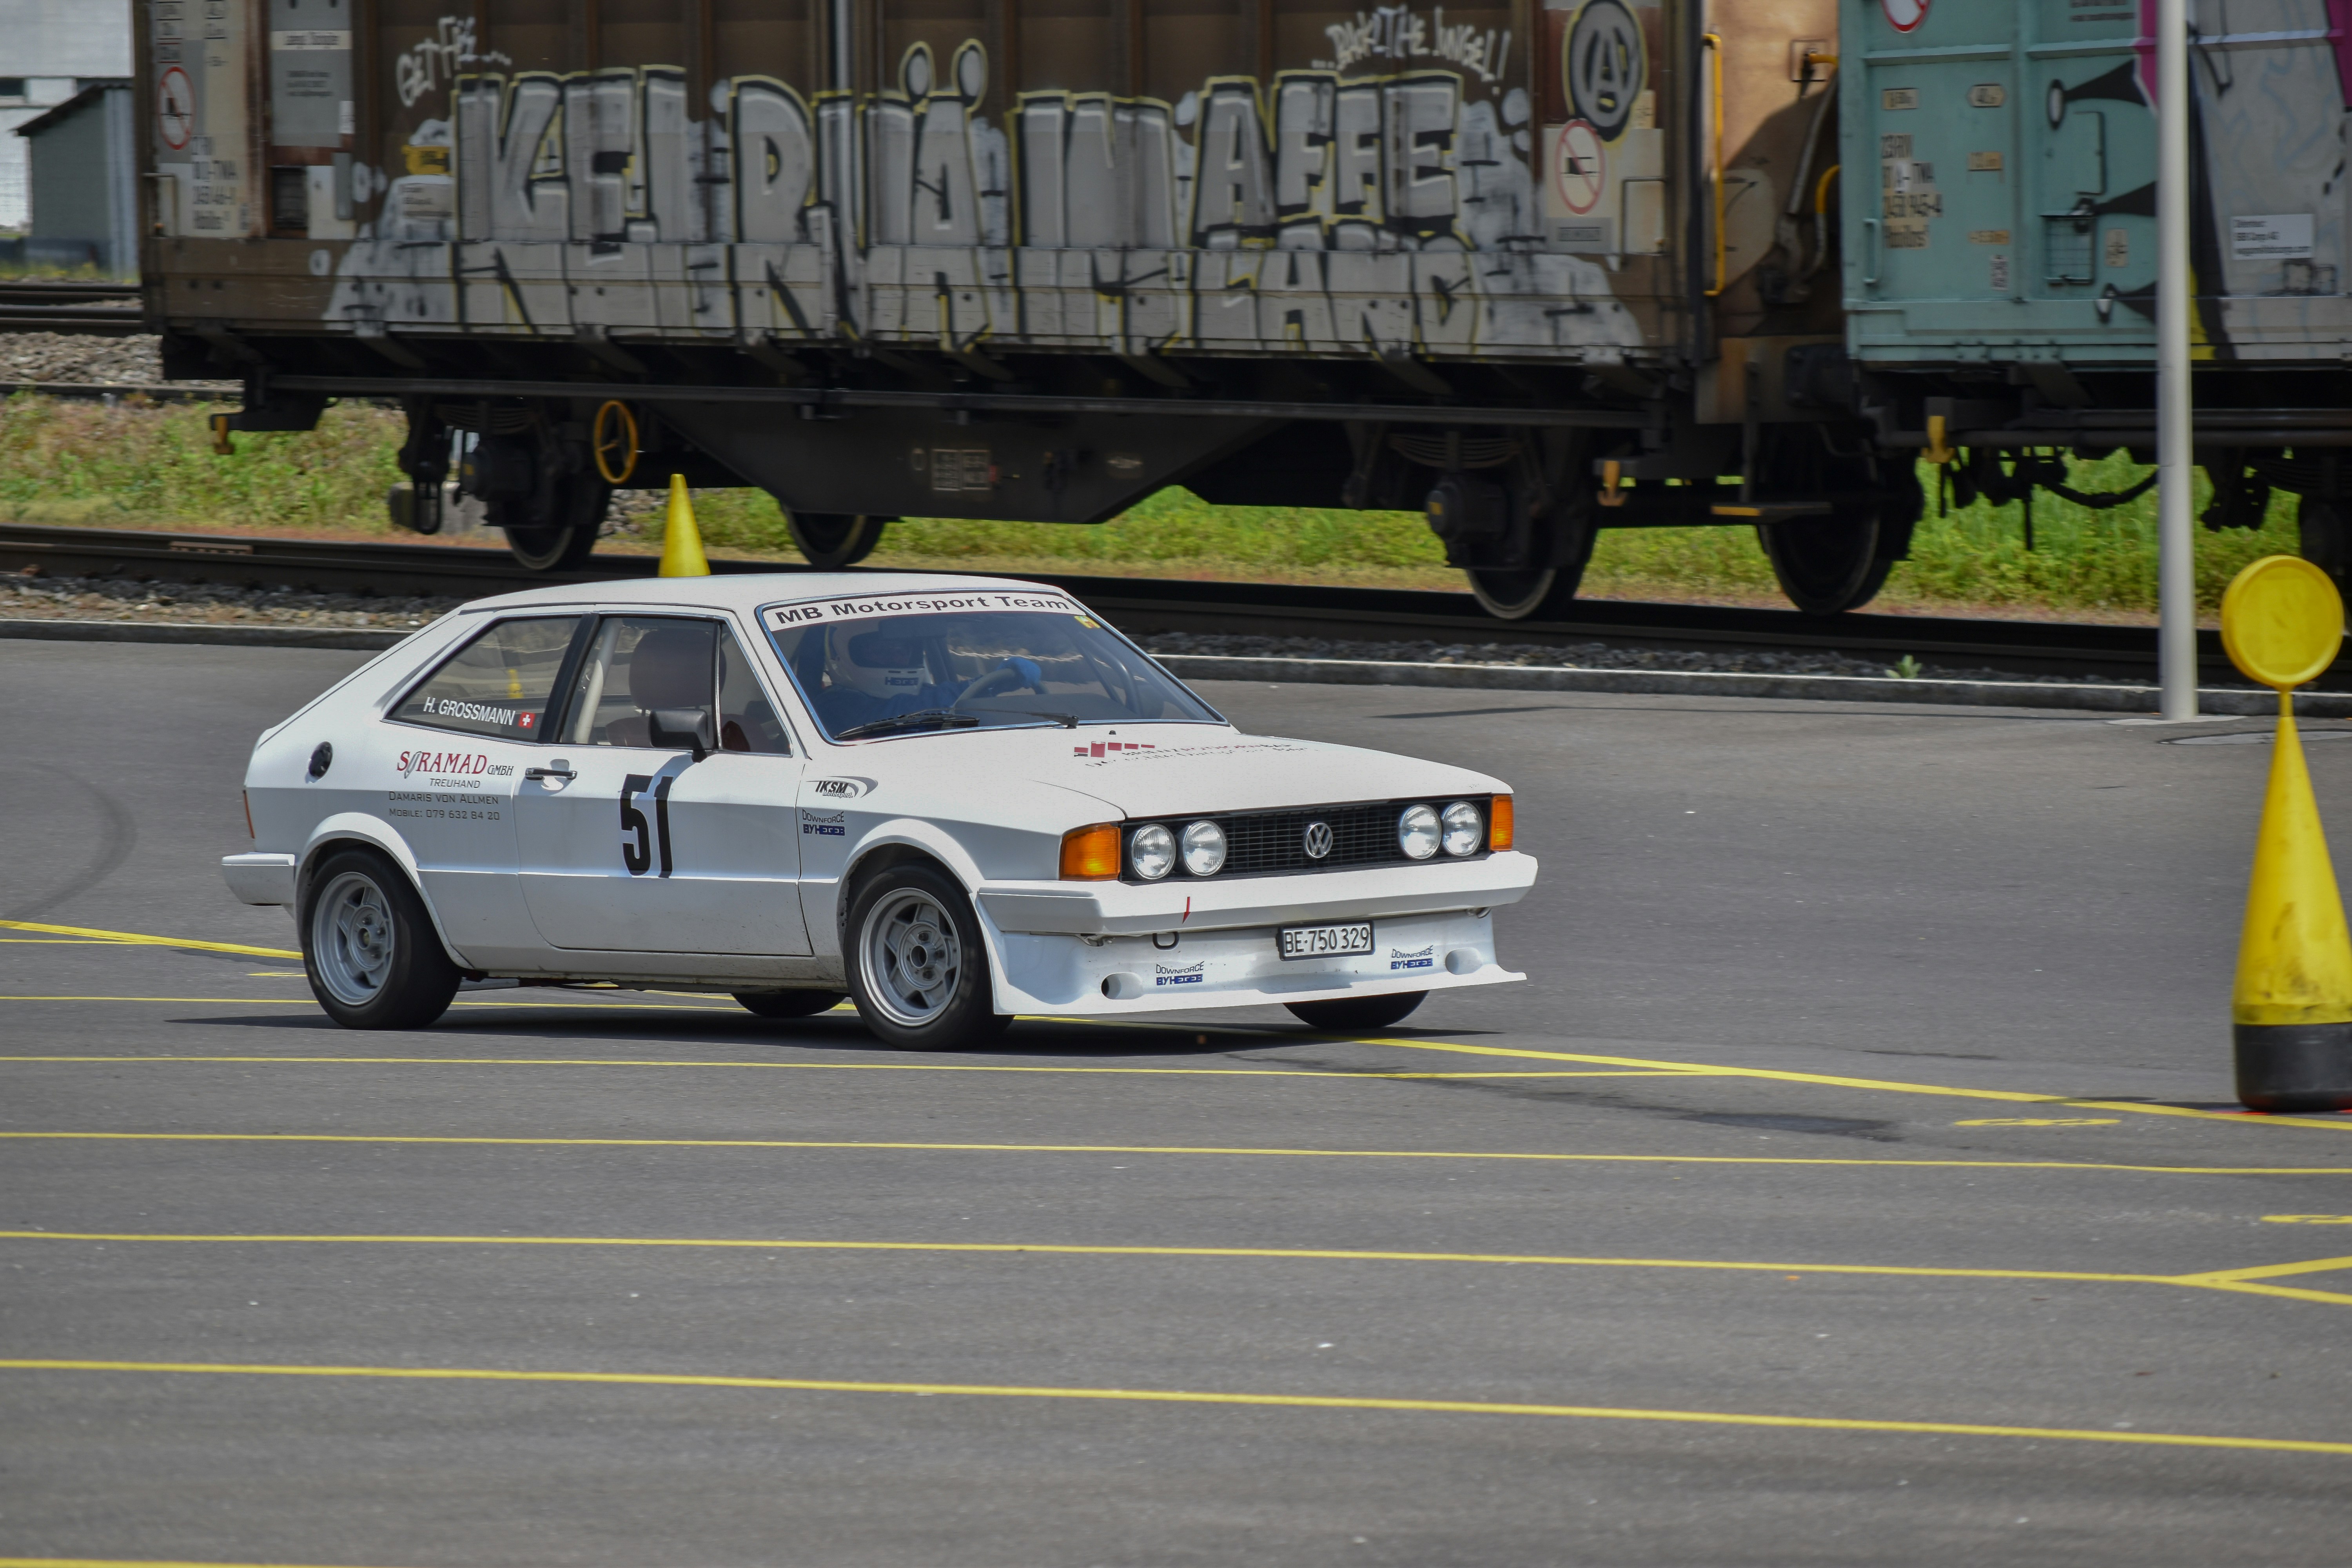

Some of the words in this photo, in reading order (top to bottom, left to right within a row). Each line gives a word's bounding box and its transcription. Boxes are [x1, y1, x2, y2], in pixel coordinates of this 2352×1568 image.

[775, 607, 823, 624] MB
[830, 597, 989, 615] Motorsport
[994, 596, 1070, 610] Team
[423, 697, 436, 713] H.
[439, 699, 515, 725] GROSSMANN
[430, 778, 480, 788] TREUHAND
[426, 809, 445, 818] 079
[449, 810, 467, 819] 632
[471, 811, 483, 820] 84
[487, 812, 499, 820] 20
[620, 774, 673, 878] 51
